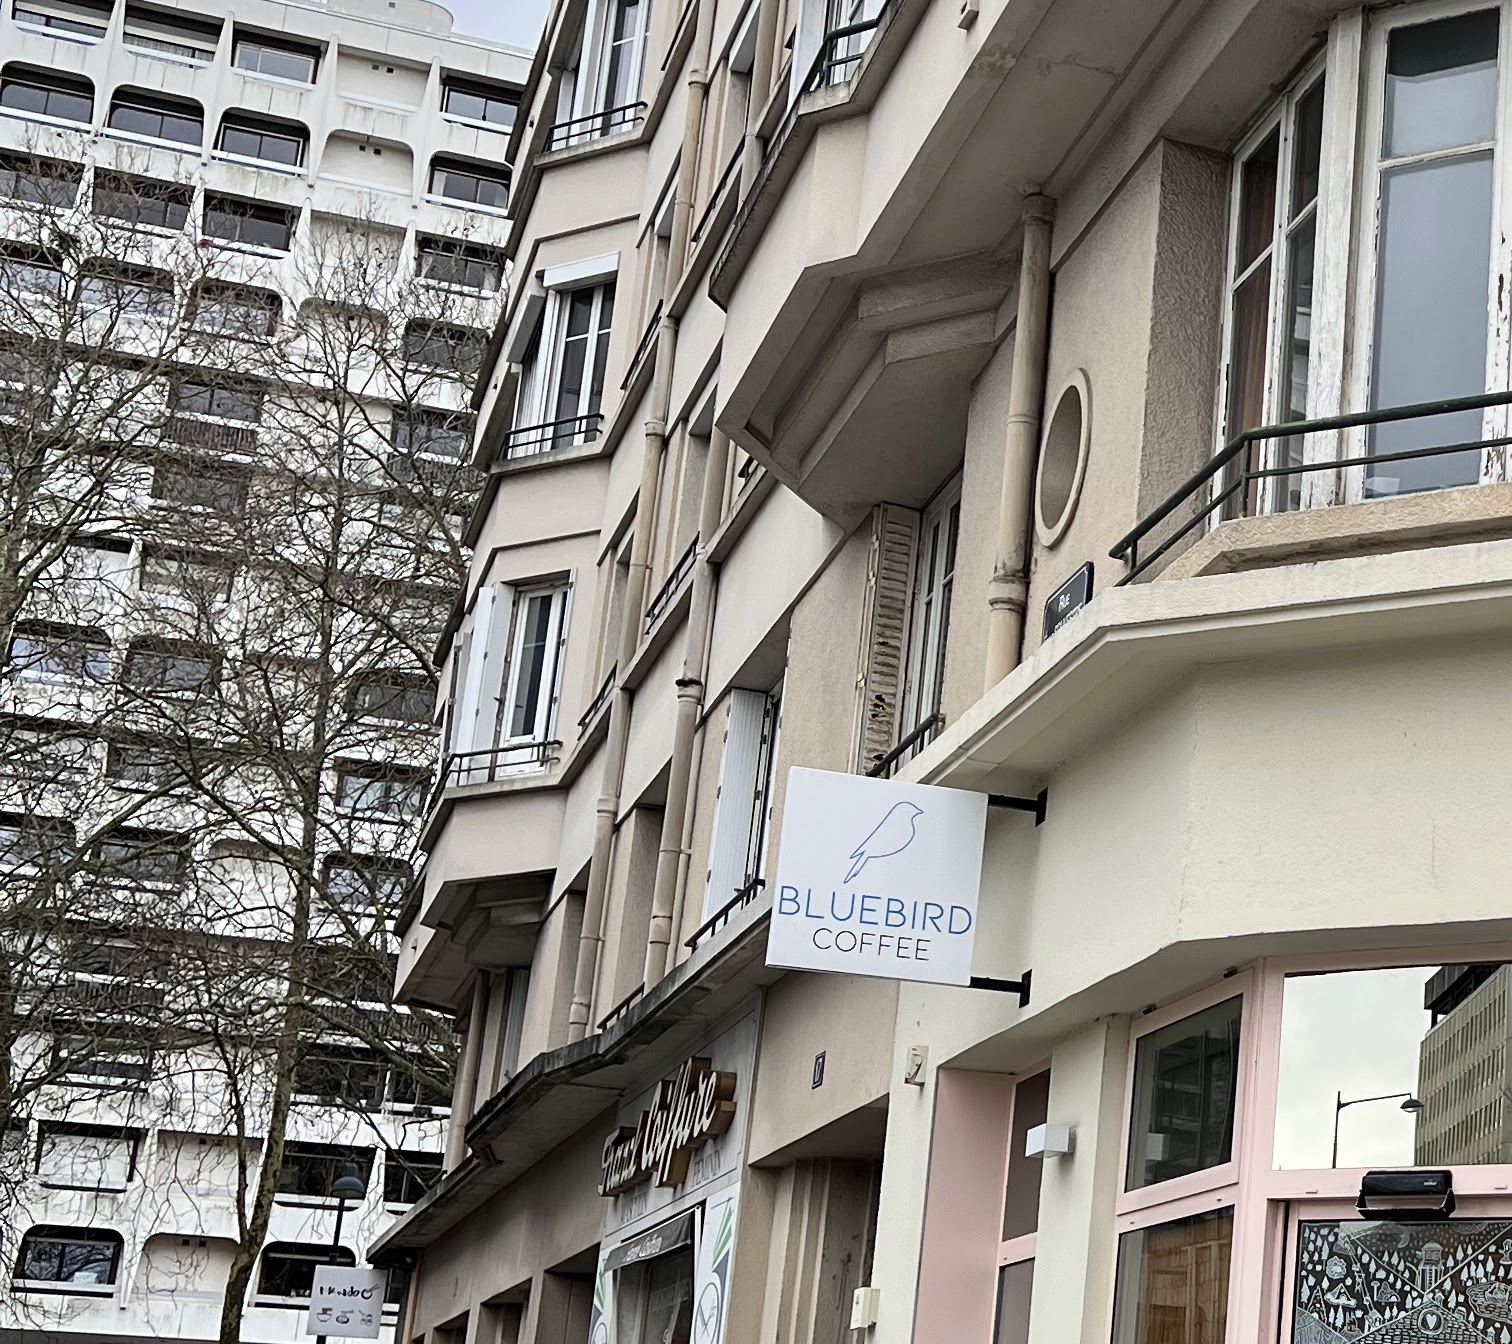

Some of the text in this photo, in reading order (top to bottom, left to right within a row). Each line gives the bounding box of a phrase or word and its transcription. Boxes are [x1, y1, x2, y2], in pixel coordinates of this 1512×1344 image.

[778, 885, 972, 935] BLUEBIRD
[812, 927, 932, 961] COFFEE
[640, 1057, 717, 1188] Coiffure
